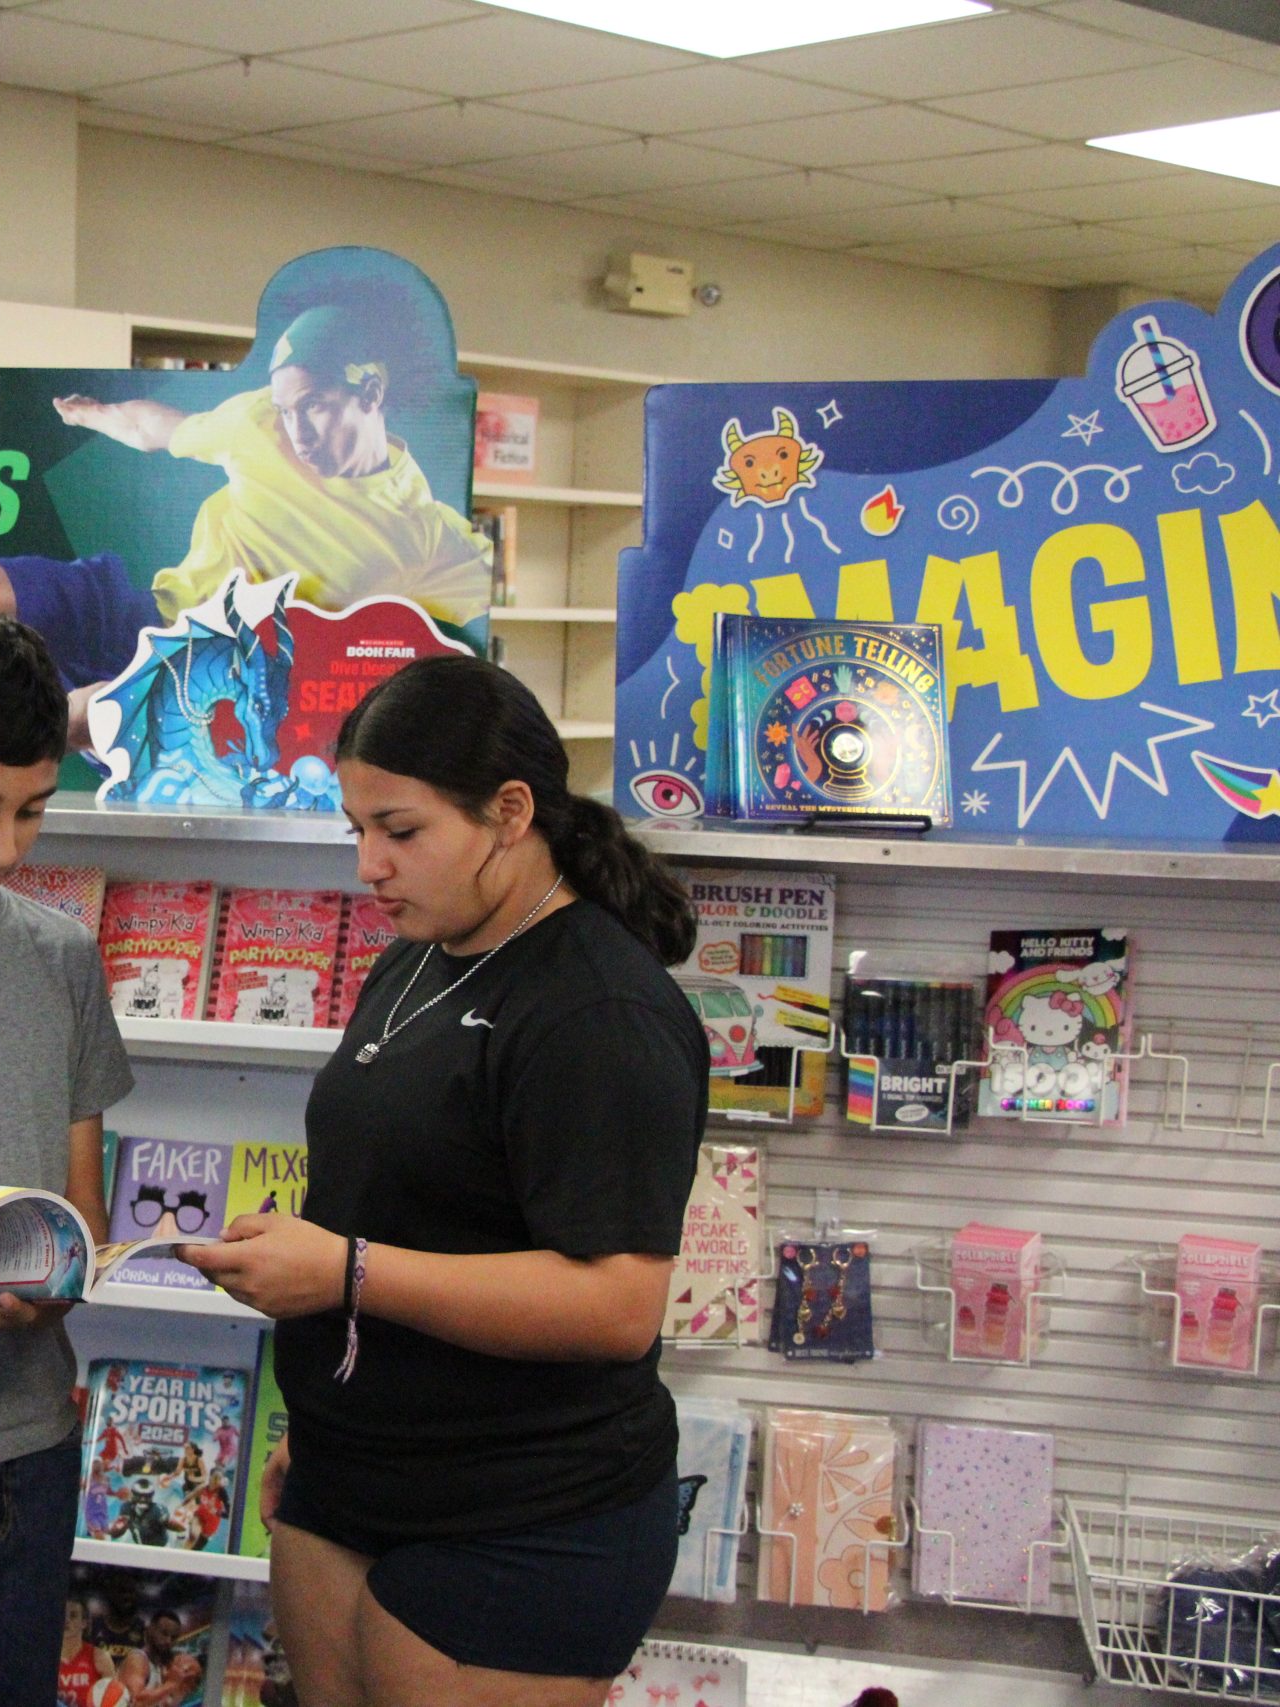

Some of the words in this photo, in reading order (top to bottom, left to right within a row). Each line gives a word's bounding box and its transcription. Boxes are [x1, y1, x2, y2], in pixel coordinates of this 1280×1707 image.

[671, 499, 1280, 752] AGIN
[346, 646, 382, 658] BOOK
[384, 647, 416, 659] FAIR
[754, 634, 846, 687] FORTUNE
[853, 636, 936, 693] TELLING
[691, 883, 776, 905] BRUSH
[778, 888, 825, 906] PEN
[58, 897, 84, 917] Kid
[692, 903, 739, 918] OLOR
[743, 905, 756, 918] &
[759, 905, 829, 921] DOODLE
[116, 912, 169, 937] Wimpy
[170, 912, 199, 932] Kid
[240, 921, 293, 945] Wimpy
[296, 921, 326, 942] Kid
[732, 919, 780, 931] COLORING
[780, 921, 829, 933] ACTIVITIES
[361, 928, 399, 947] Wim
[1020, 937, 1057, 948] HELLO
[1059, 936, 1095, 948] KITTY
[1019, 947, 1046, 958] AND
[1047, 946, 1095, 958] FRIENDS
[880, 1075, 947, 1093] BRIGHT
[131, 1141, 222, 1186] FAKER
[687, 1204, 708, 1220] BE
[711, 1205, 721, 1220] A
[681, 1223, 738, 1238] UPCAKE
[696, 1240, 748, 1256] WORLD
[113, 1267, 160, 1284] GORDON
[686, 1259, 750, 1275] MUFFINS
[128, 1374, 185, 1398] YEAR
[189, 1378, 215, 1401] IN
[111, 1393, 224, 1434] SPORTS
[140, 1423, 186, 1445] 2026
